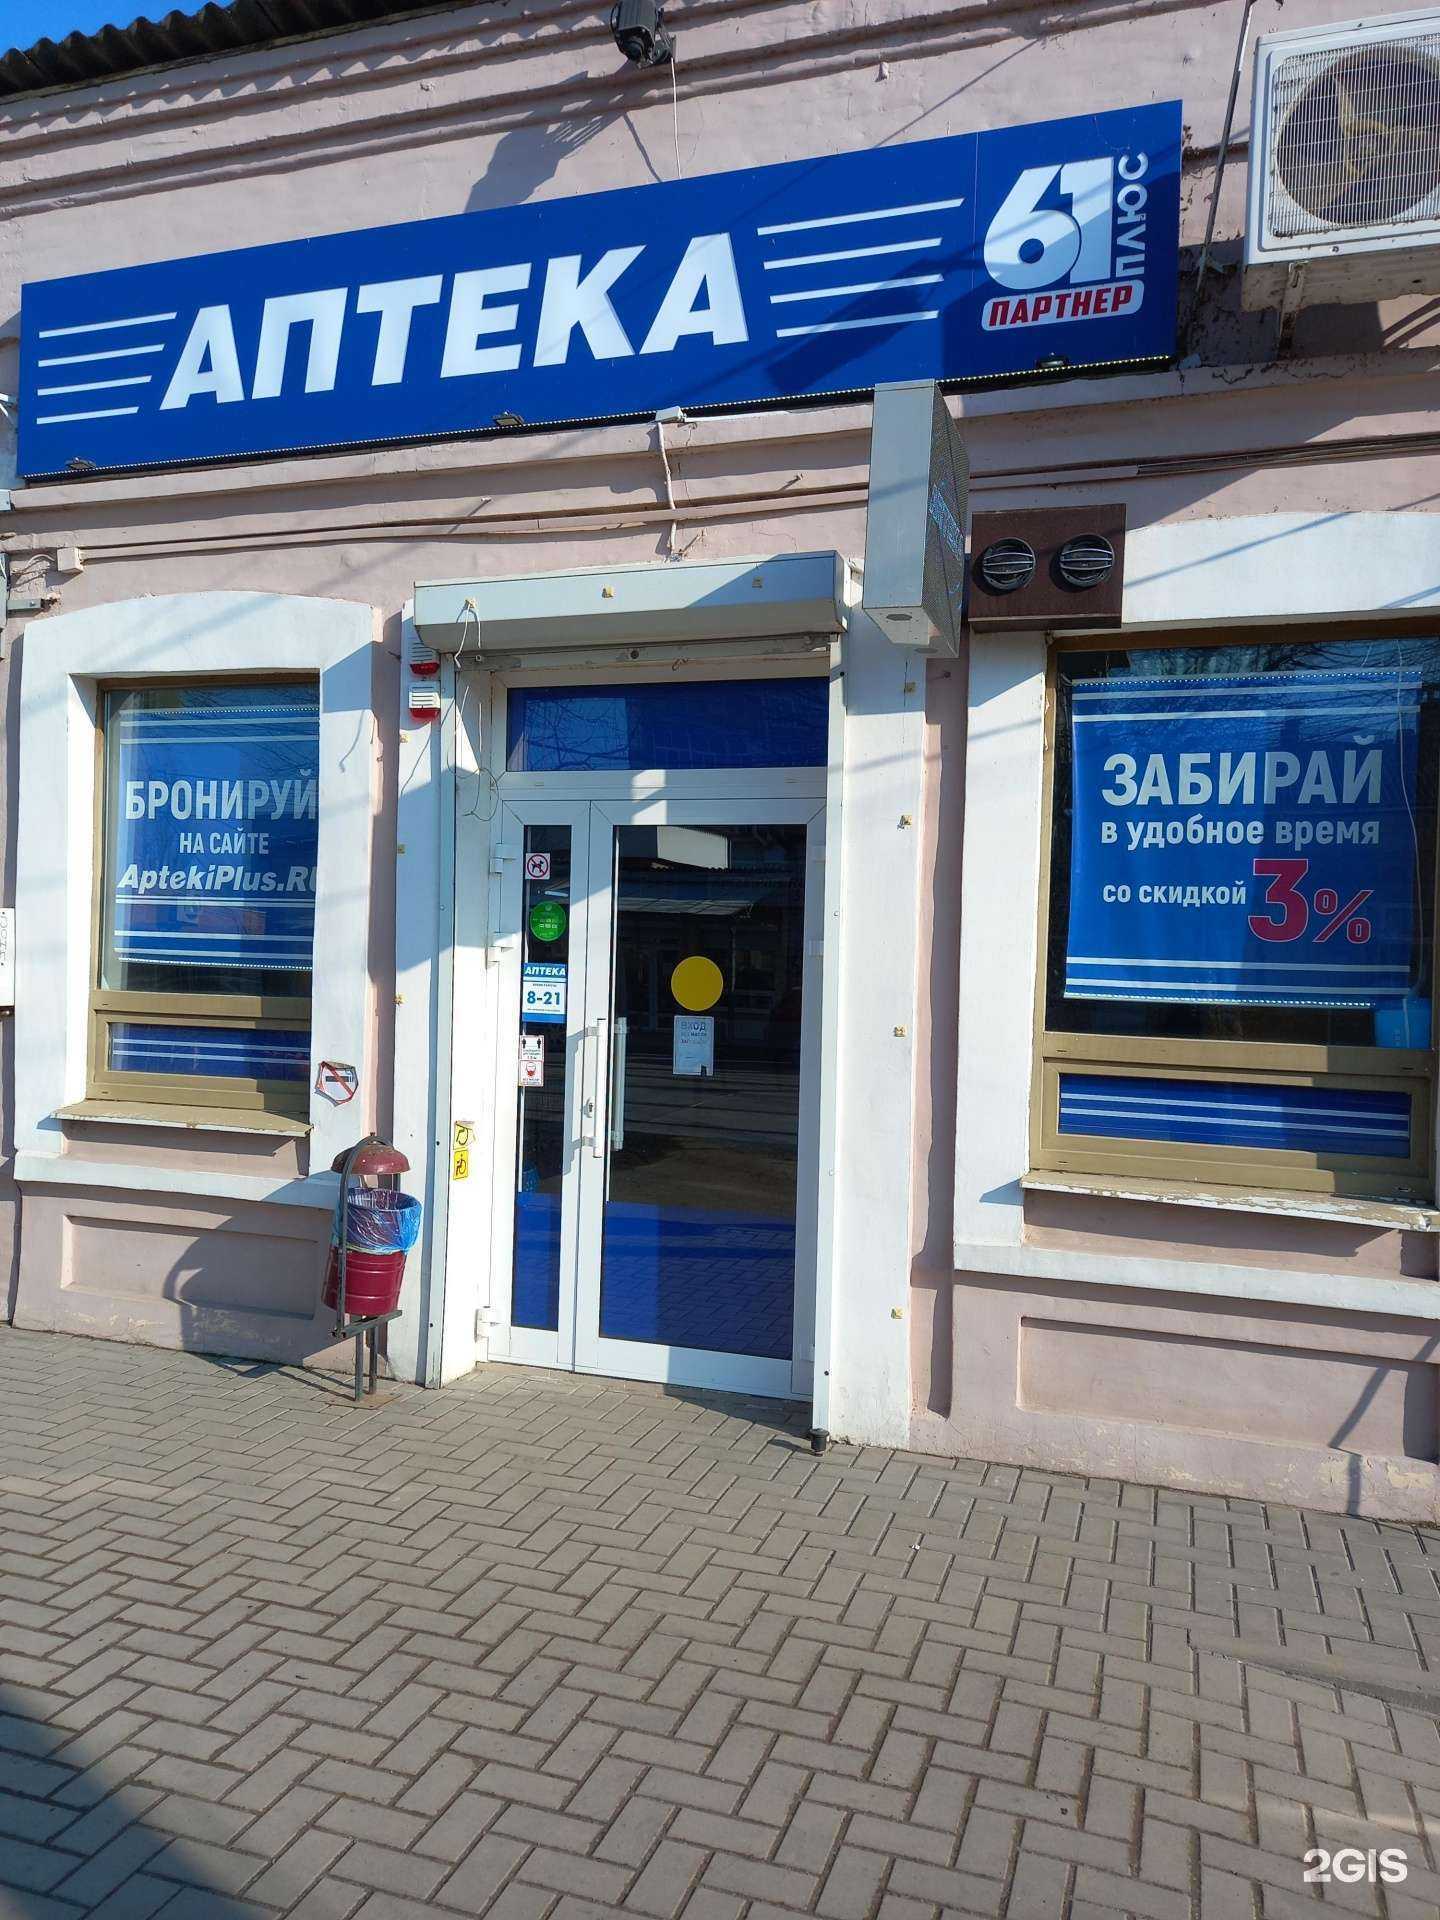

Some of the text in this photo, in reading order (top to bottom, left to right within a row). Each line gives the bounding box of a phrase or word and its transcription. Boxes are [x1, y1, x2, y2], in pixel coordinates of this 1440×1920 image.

[983, 156, 1114, 290] 61
[1115, 151, 1149, 278] ПЛЮС
[159, 232, 749, 411] АПТЕКА
[988, 284, 1133, 327] ПАРТНЕР
[125, 768, 317, 820] БРОНИРУЙ
[1101, 734, 1384, 807] ЗАБИРАЙ
[179, 827, 270, 855] НА САЙТЕ
[1101, 813, 1381, 851] в удобное время
[1102, 857, 1376, 944] со скидкой 3%
[524, 966, 566, 976] АПТЕКА
[526, 990, 560, 1006] 8-21
